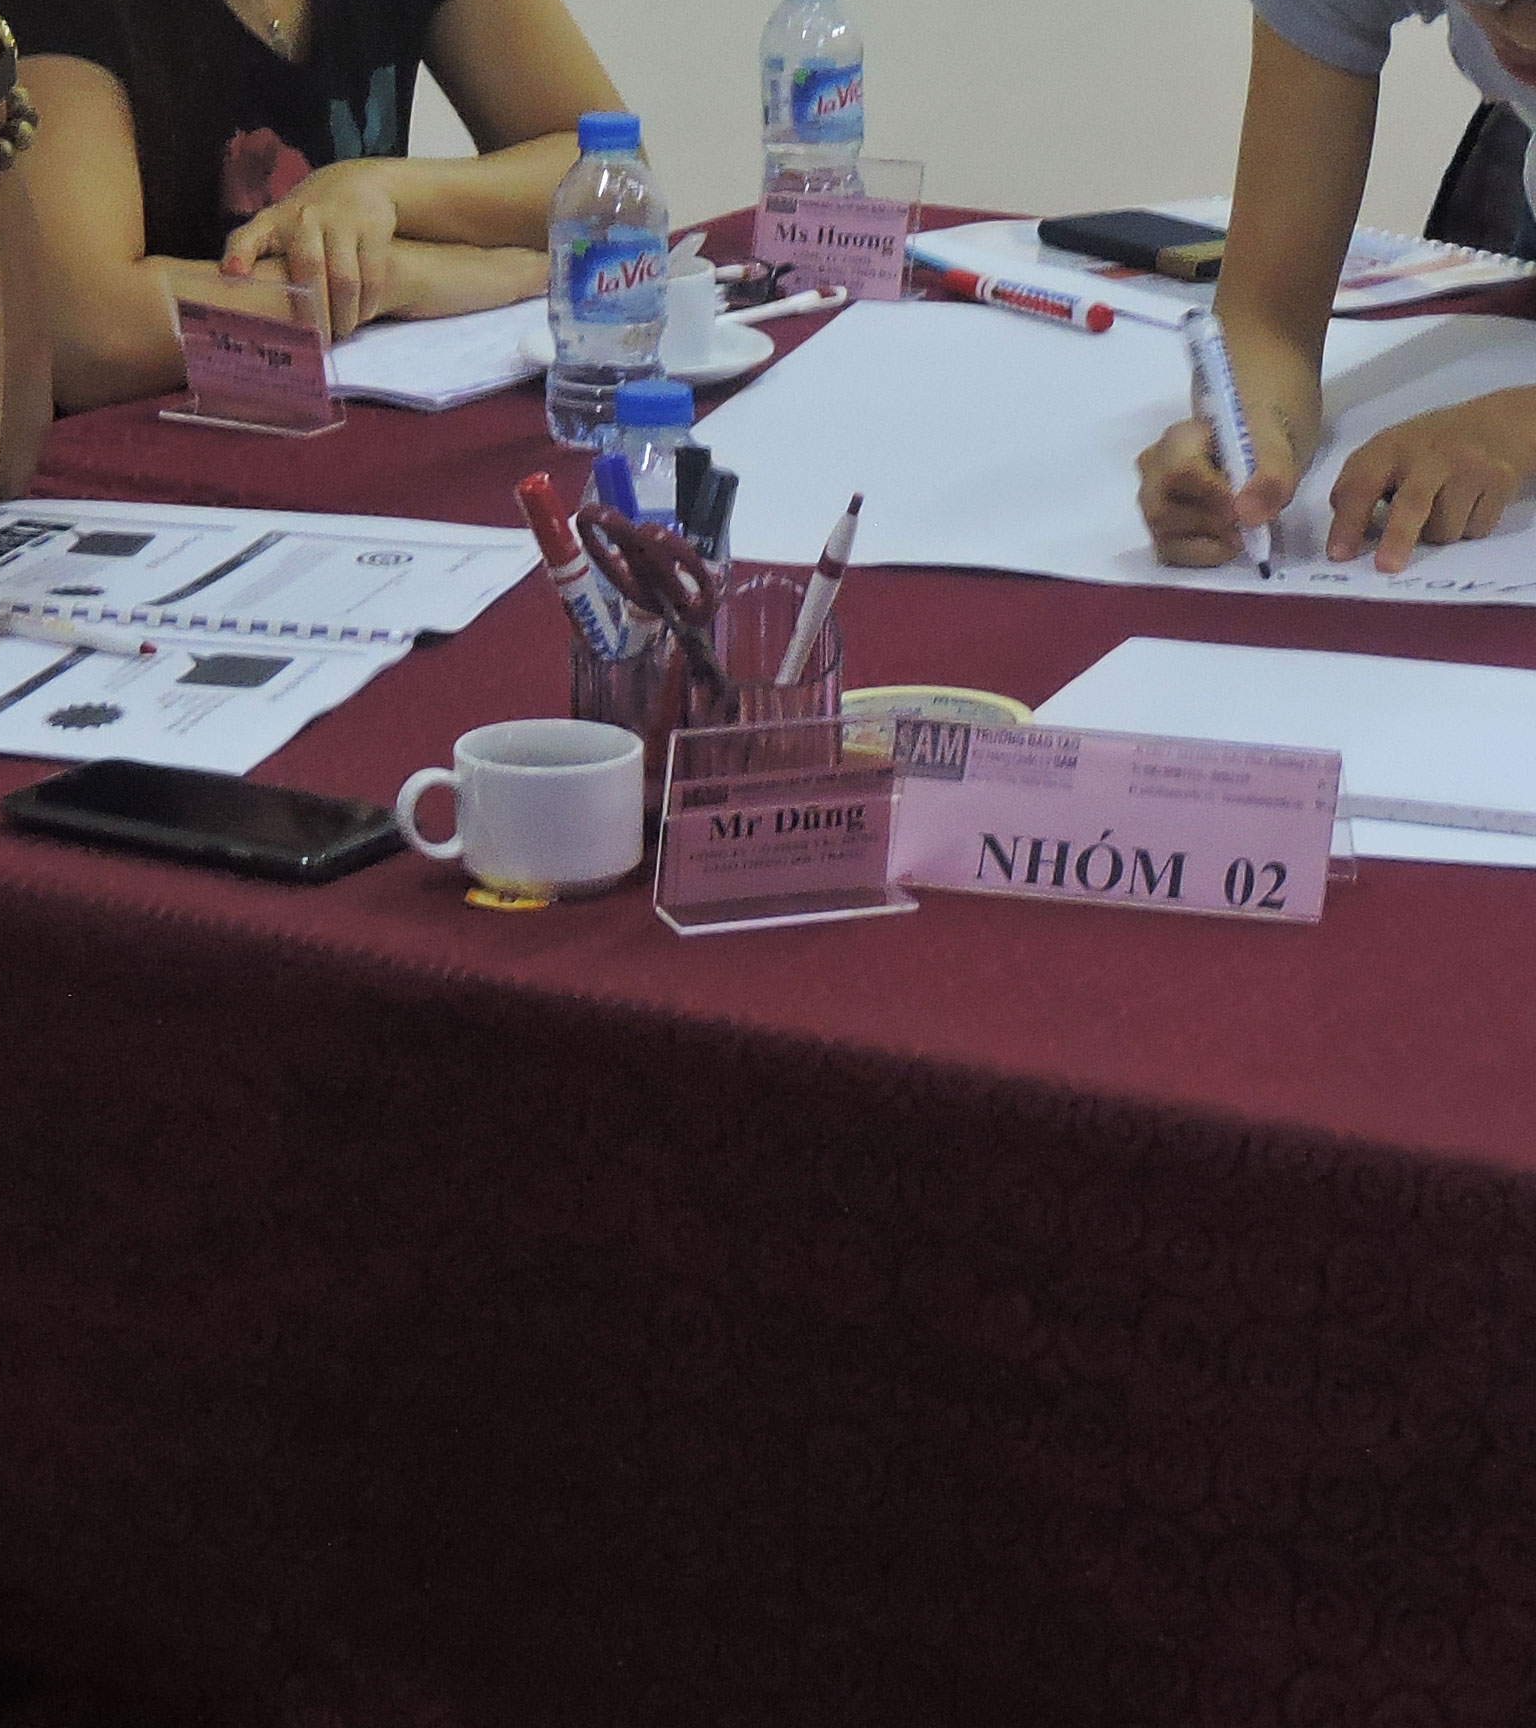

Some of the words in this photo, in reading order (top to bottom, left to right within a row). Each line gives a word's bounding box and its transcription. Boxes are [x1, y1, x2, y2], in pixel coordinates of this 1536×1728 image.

[775, 222, 808, 245] Ms
[710, 810, 763, 842] Mr
[976, 828, 1188, 901] NHÓM
[1224, 856, 1288, 911] 02
